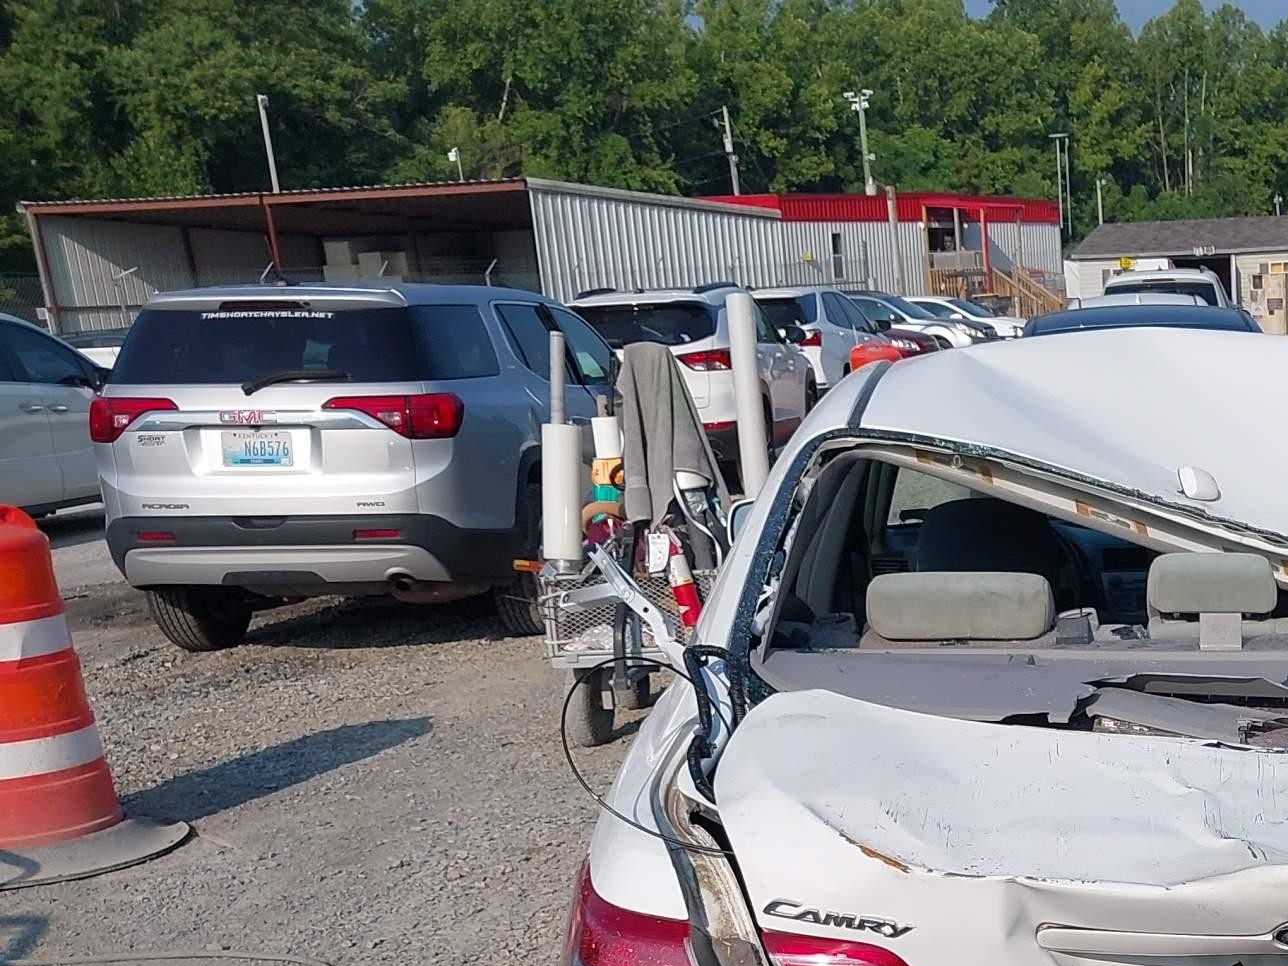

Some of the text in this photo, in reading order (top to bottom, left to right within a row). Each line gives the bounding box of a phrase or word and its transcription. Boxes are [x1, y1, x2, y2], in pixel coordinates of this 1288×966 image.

[201, 311, 334, 319] TIMSHORTCHRYSLER.NET
[220, 409, 278, 424] GMC
[244, 440, 290, 457] N6B576
[762, 897, 917, 938] CAMRY
